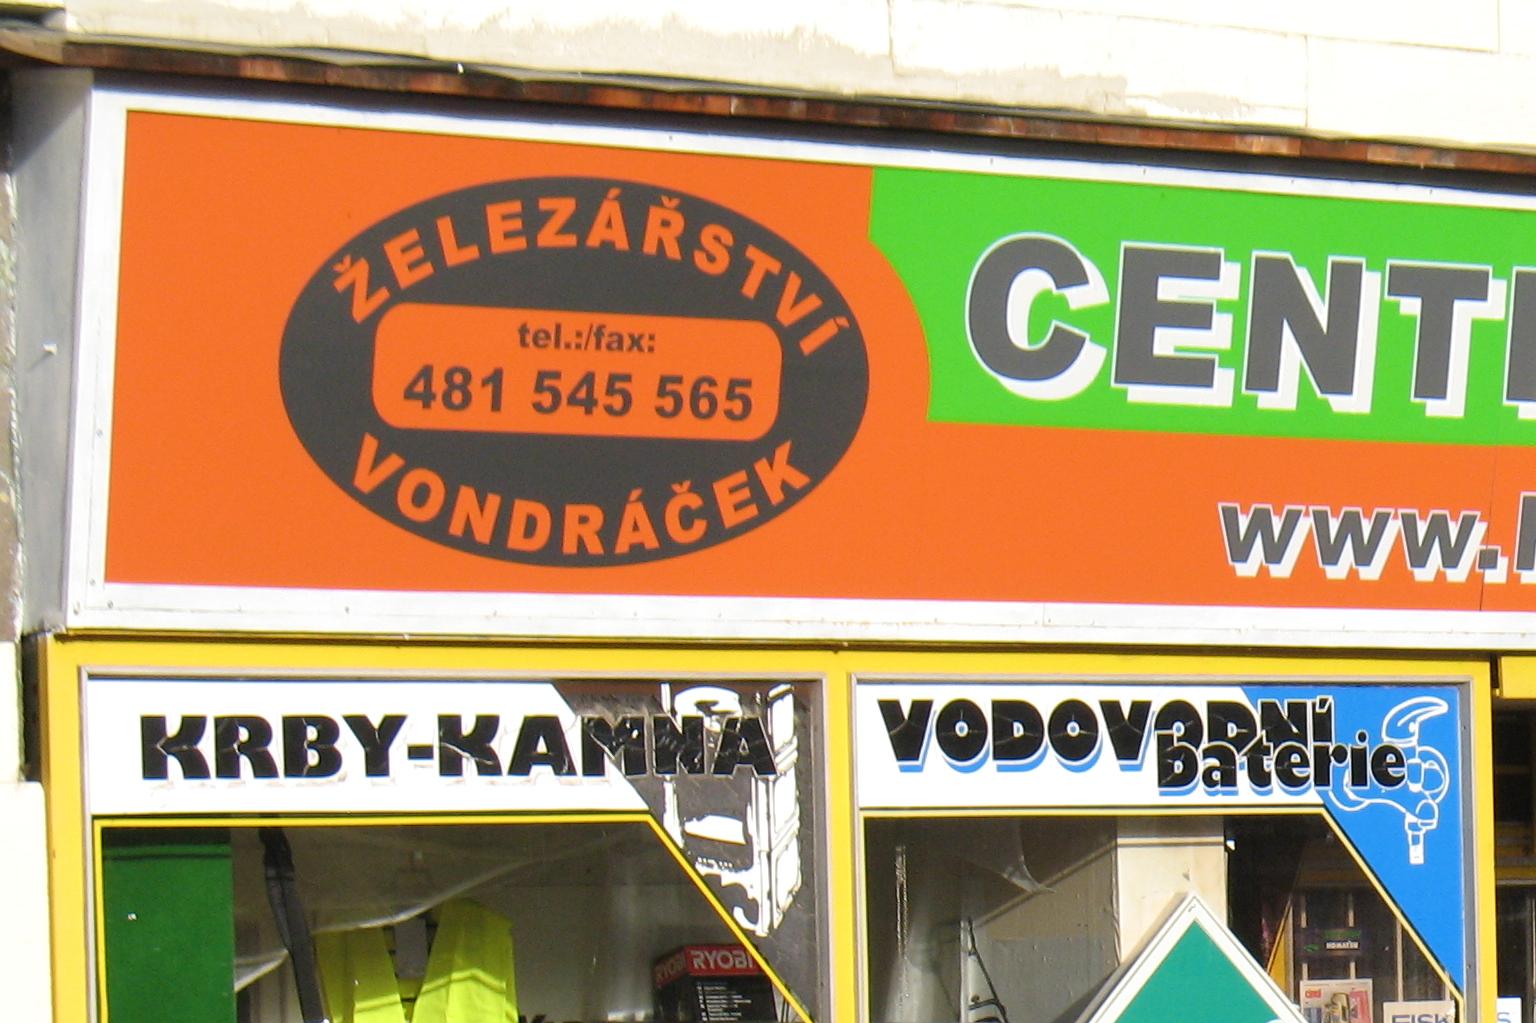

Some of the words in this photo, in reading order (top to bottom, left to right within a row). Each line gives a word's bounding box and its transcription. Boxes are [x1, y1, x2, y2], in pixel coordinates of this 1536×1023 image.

[333, 187, 851, 357] ŽELEZÁŘSTVÍ
[517, 321, 657, 355] tel.:/fax:
[403, 364, 505, 414] 481
[531, 369, 634, 418] 545
[654, 374, 755, 423] 565
[351, 433, 813, 556] VONDRÁČEK
[139, 714, 778, 780] KRBY-KAMNA
[877, 697, 1337, 772] VODOVODNÍ
[1156, 728, 1408, 796] baterie
[692, 950, 754, 970] RYOBI
